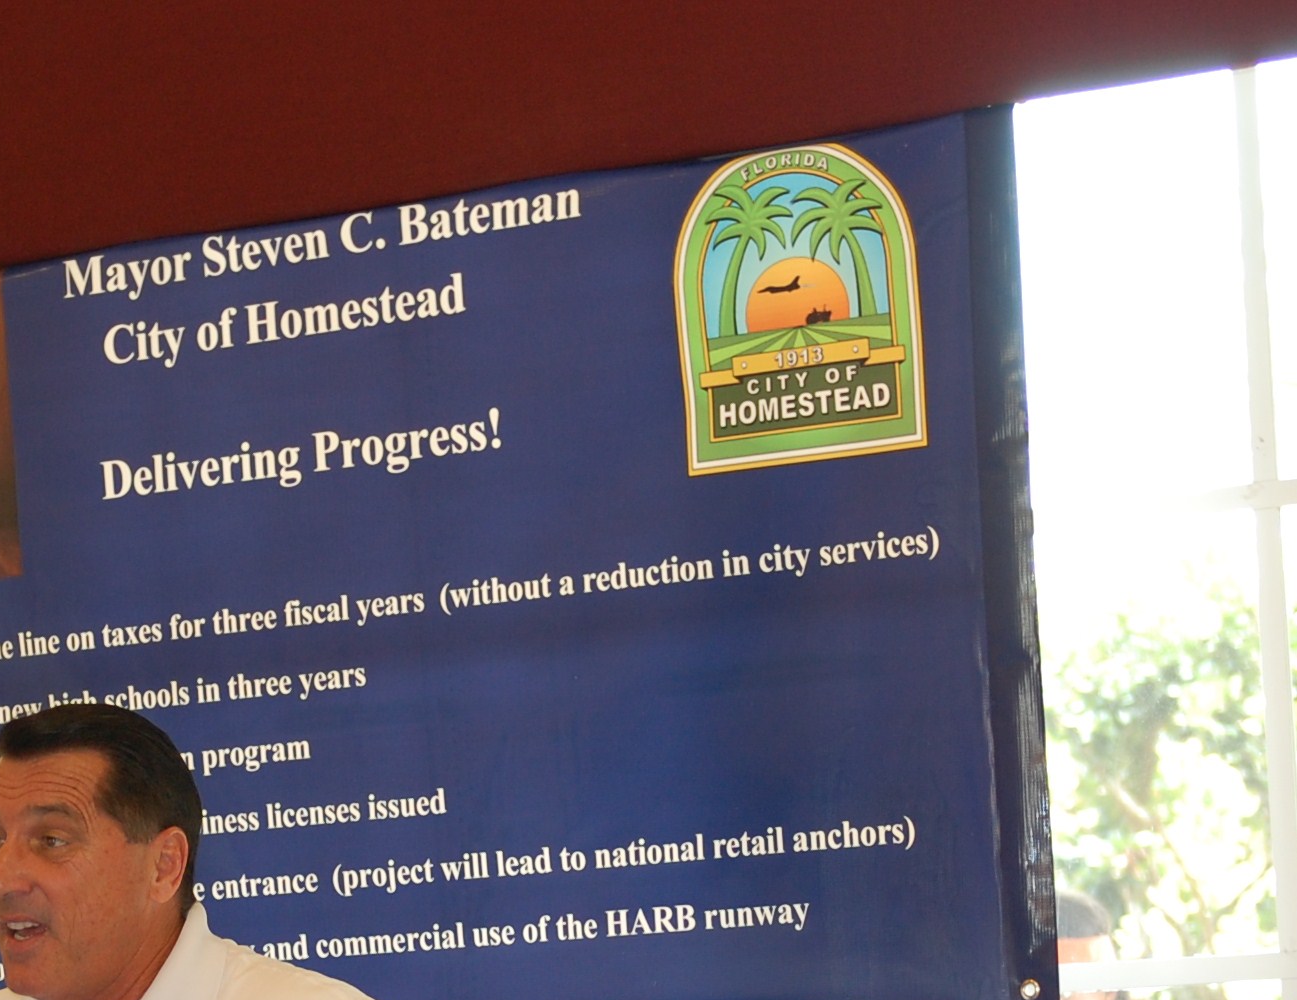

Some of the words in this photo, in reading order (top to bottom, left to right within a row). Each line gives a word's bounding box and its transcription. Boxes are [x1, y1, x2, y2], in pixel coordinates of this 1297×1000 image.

[741, 152, 829, 182] FLORIDA
[64, 252, 192, 301] Mayor
[202, 230, 330, 278] Steven
[340, 212, 386, 254] C.
[399, 188, 581, 247] Bateman
[103, 320, 186, 369] City
[196, 306, 237, 352] of
[244, 271, 466, 345] Homestead
[746, 372, 808, 396] CITY
[825, 364, 859, 384] OF
[775, 347, 824, 368] 1913
[719, 382, 891, 429] HOMESTEAD
[100, 440, 302, 501] Delivering
[311, 406, 502, 475] Progress!
[18, 630, 60, 658] line
[66, 630, 95, 653] on
[101, 622, 163, 649] taxes
[169, 613, 206, 641] for
[212, 607, 277, 636] three
[283, 594, 350, 627] fiscal
[355, 592, 425, 627] years
[439, 572, 552, 616] (without
[559, 575, 575, 597] a
[583, 555, 714, 594] reduction
[722, 548, 750, 578] in
[759, 542, 811, 578] city
[819, 524, 939, 567] services)
[104, 680, 190, 712] schools
[196, 676, 221, 704] in
[227, 673, 292, 701] three
[298, 666, 367, 701] years
[201, 739, 311, 777] program
[201, 808, 260, 836] iness
[266, 801, 361, 830] licenses
[368, 787, 447, 821] issued
[211, 872, 318, 901] entrance
[332, 857, 435, 898] (project
[440, 851, 490, 882] will
[495, 845, 553, 878] lead
[559, 846, 587, 873] to
[594, 832, 705, 870] national
[713, 825, 785, 859] retail
[793, 815, 915, 853] anchors)
[262, 933, 310, 961] and
[315, 921, 466, 959] commercial
[472, 925, 516, 949] use
[522, 913, 551, 944] of
[555, 913, 598, 941] the
[605, 903, 696, 938] HARB
[704, 902, 810, 932] runway
